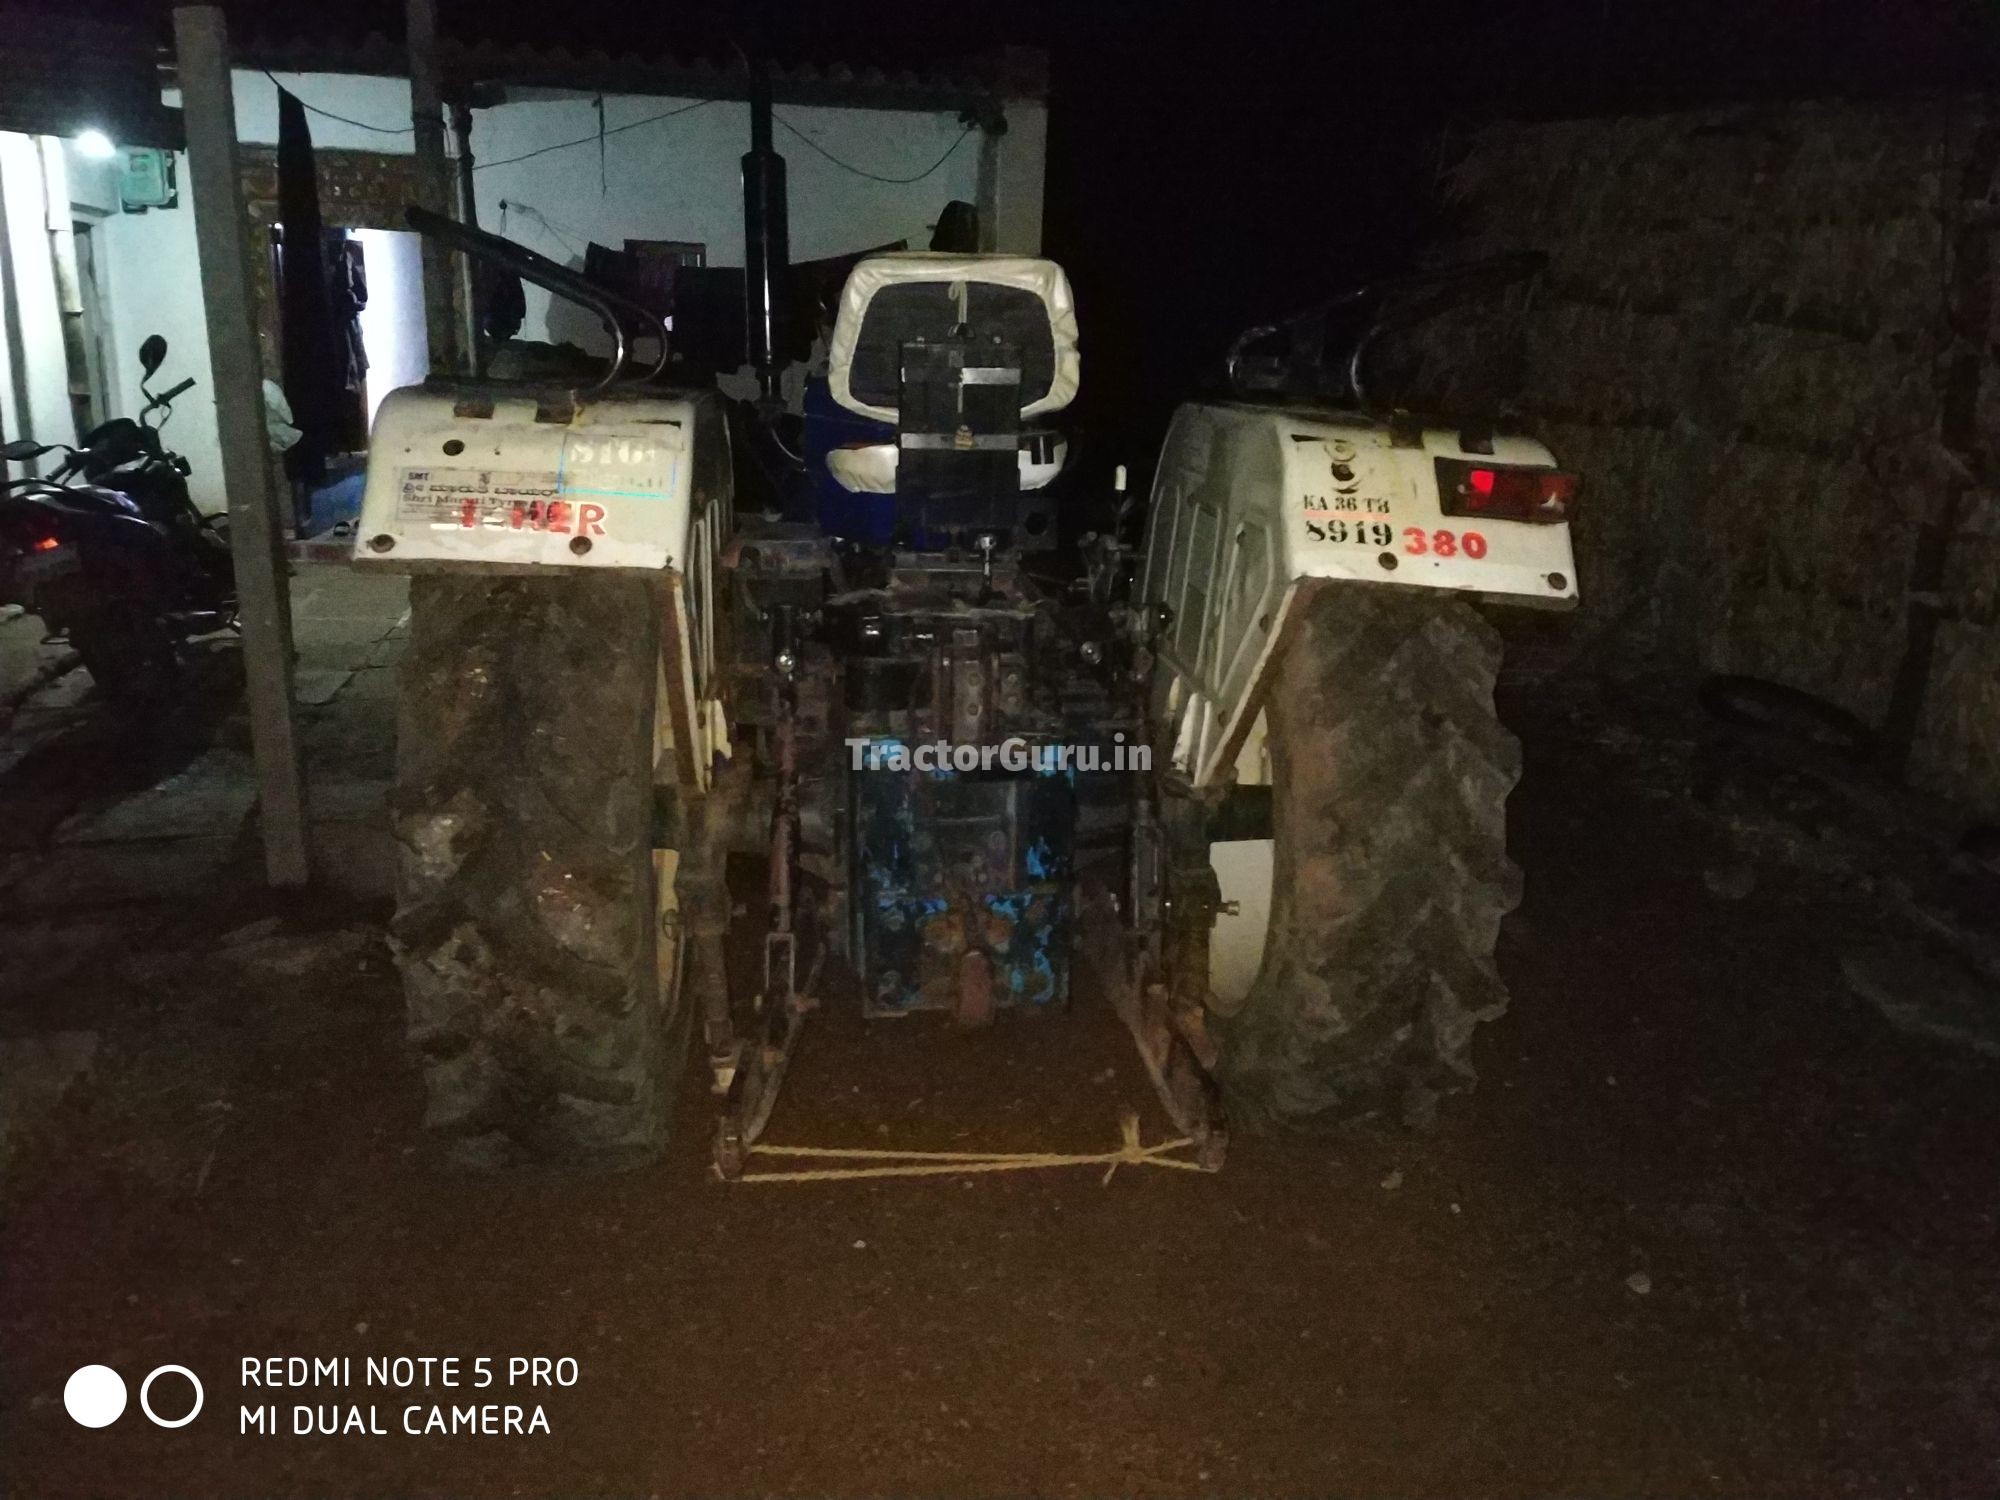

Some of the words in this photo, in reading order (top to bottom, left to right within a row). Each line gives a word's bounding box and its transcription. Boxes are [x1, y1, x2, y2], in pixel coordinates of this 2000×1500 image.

[1303, 494, 1328, 511] KA
[1334, 496, 1358, 512] 36
[1305, 518, 1393, 547] 8919
[1402, 526, 1488, 560] 380
